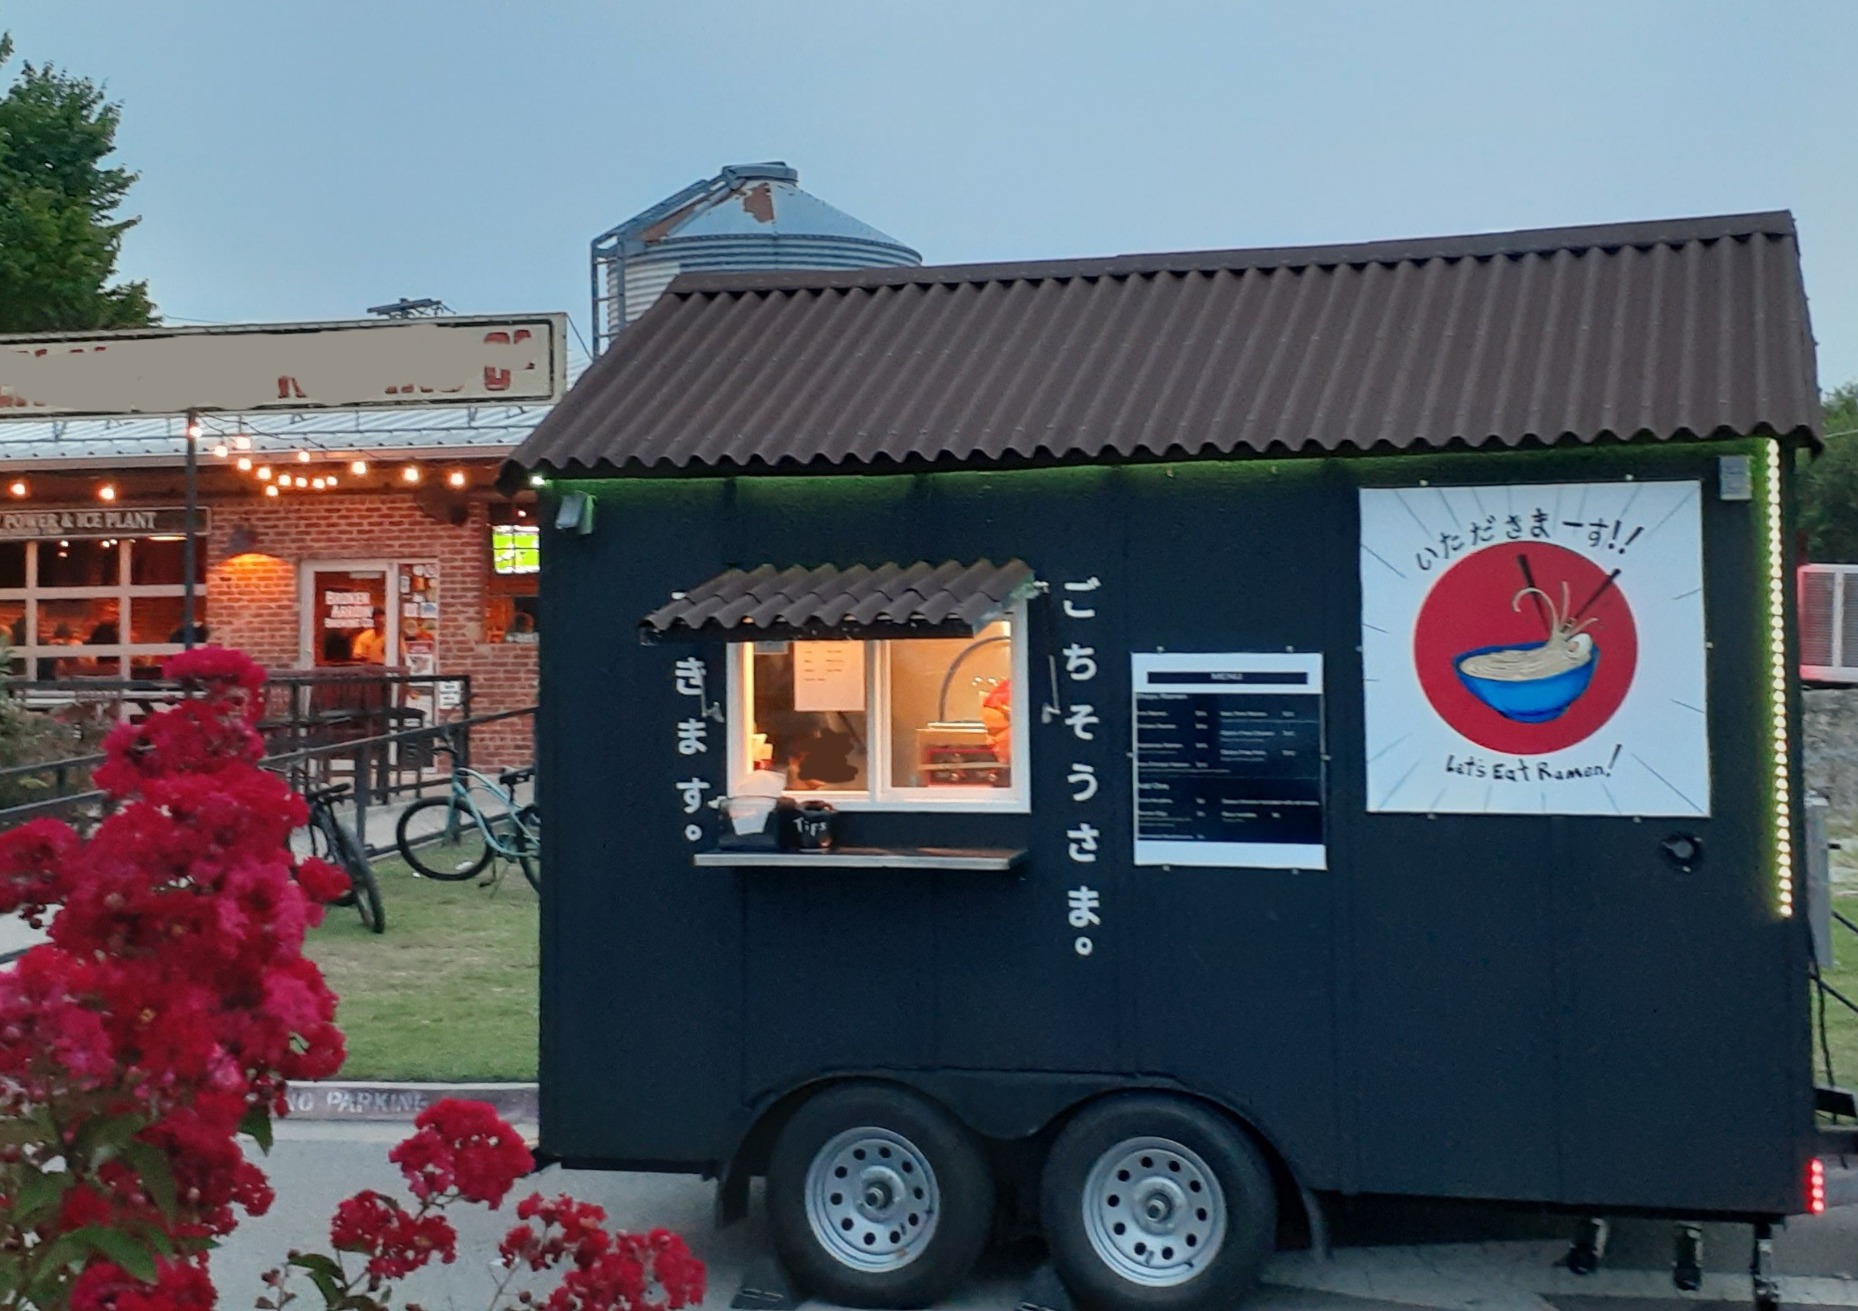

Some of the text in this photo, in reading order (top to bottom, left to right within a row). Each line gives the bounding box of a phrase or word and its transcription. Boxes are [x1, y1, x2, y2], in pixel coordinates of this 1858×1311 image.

[3, 513, 59, 529] POWER
[105, 512, 157, 529] PLANT
[1446, 755, 1487, 778] Let's
[1492, 758, 1531, 782] Eat
